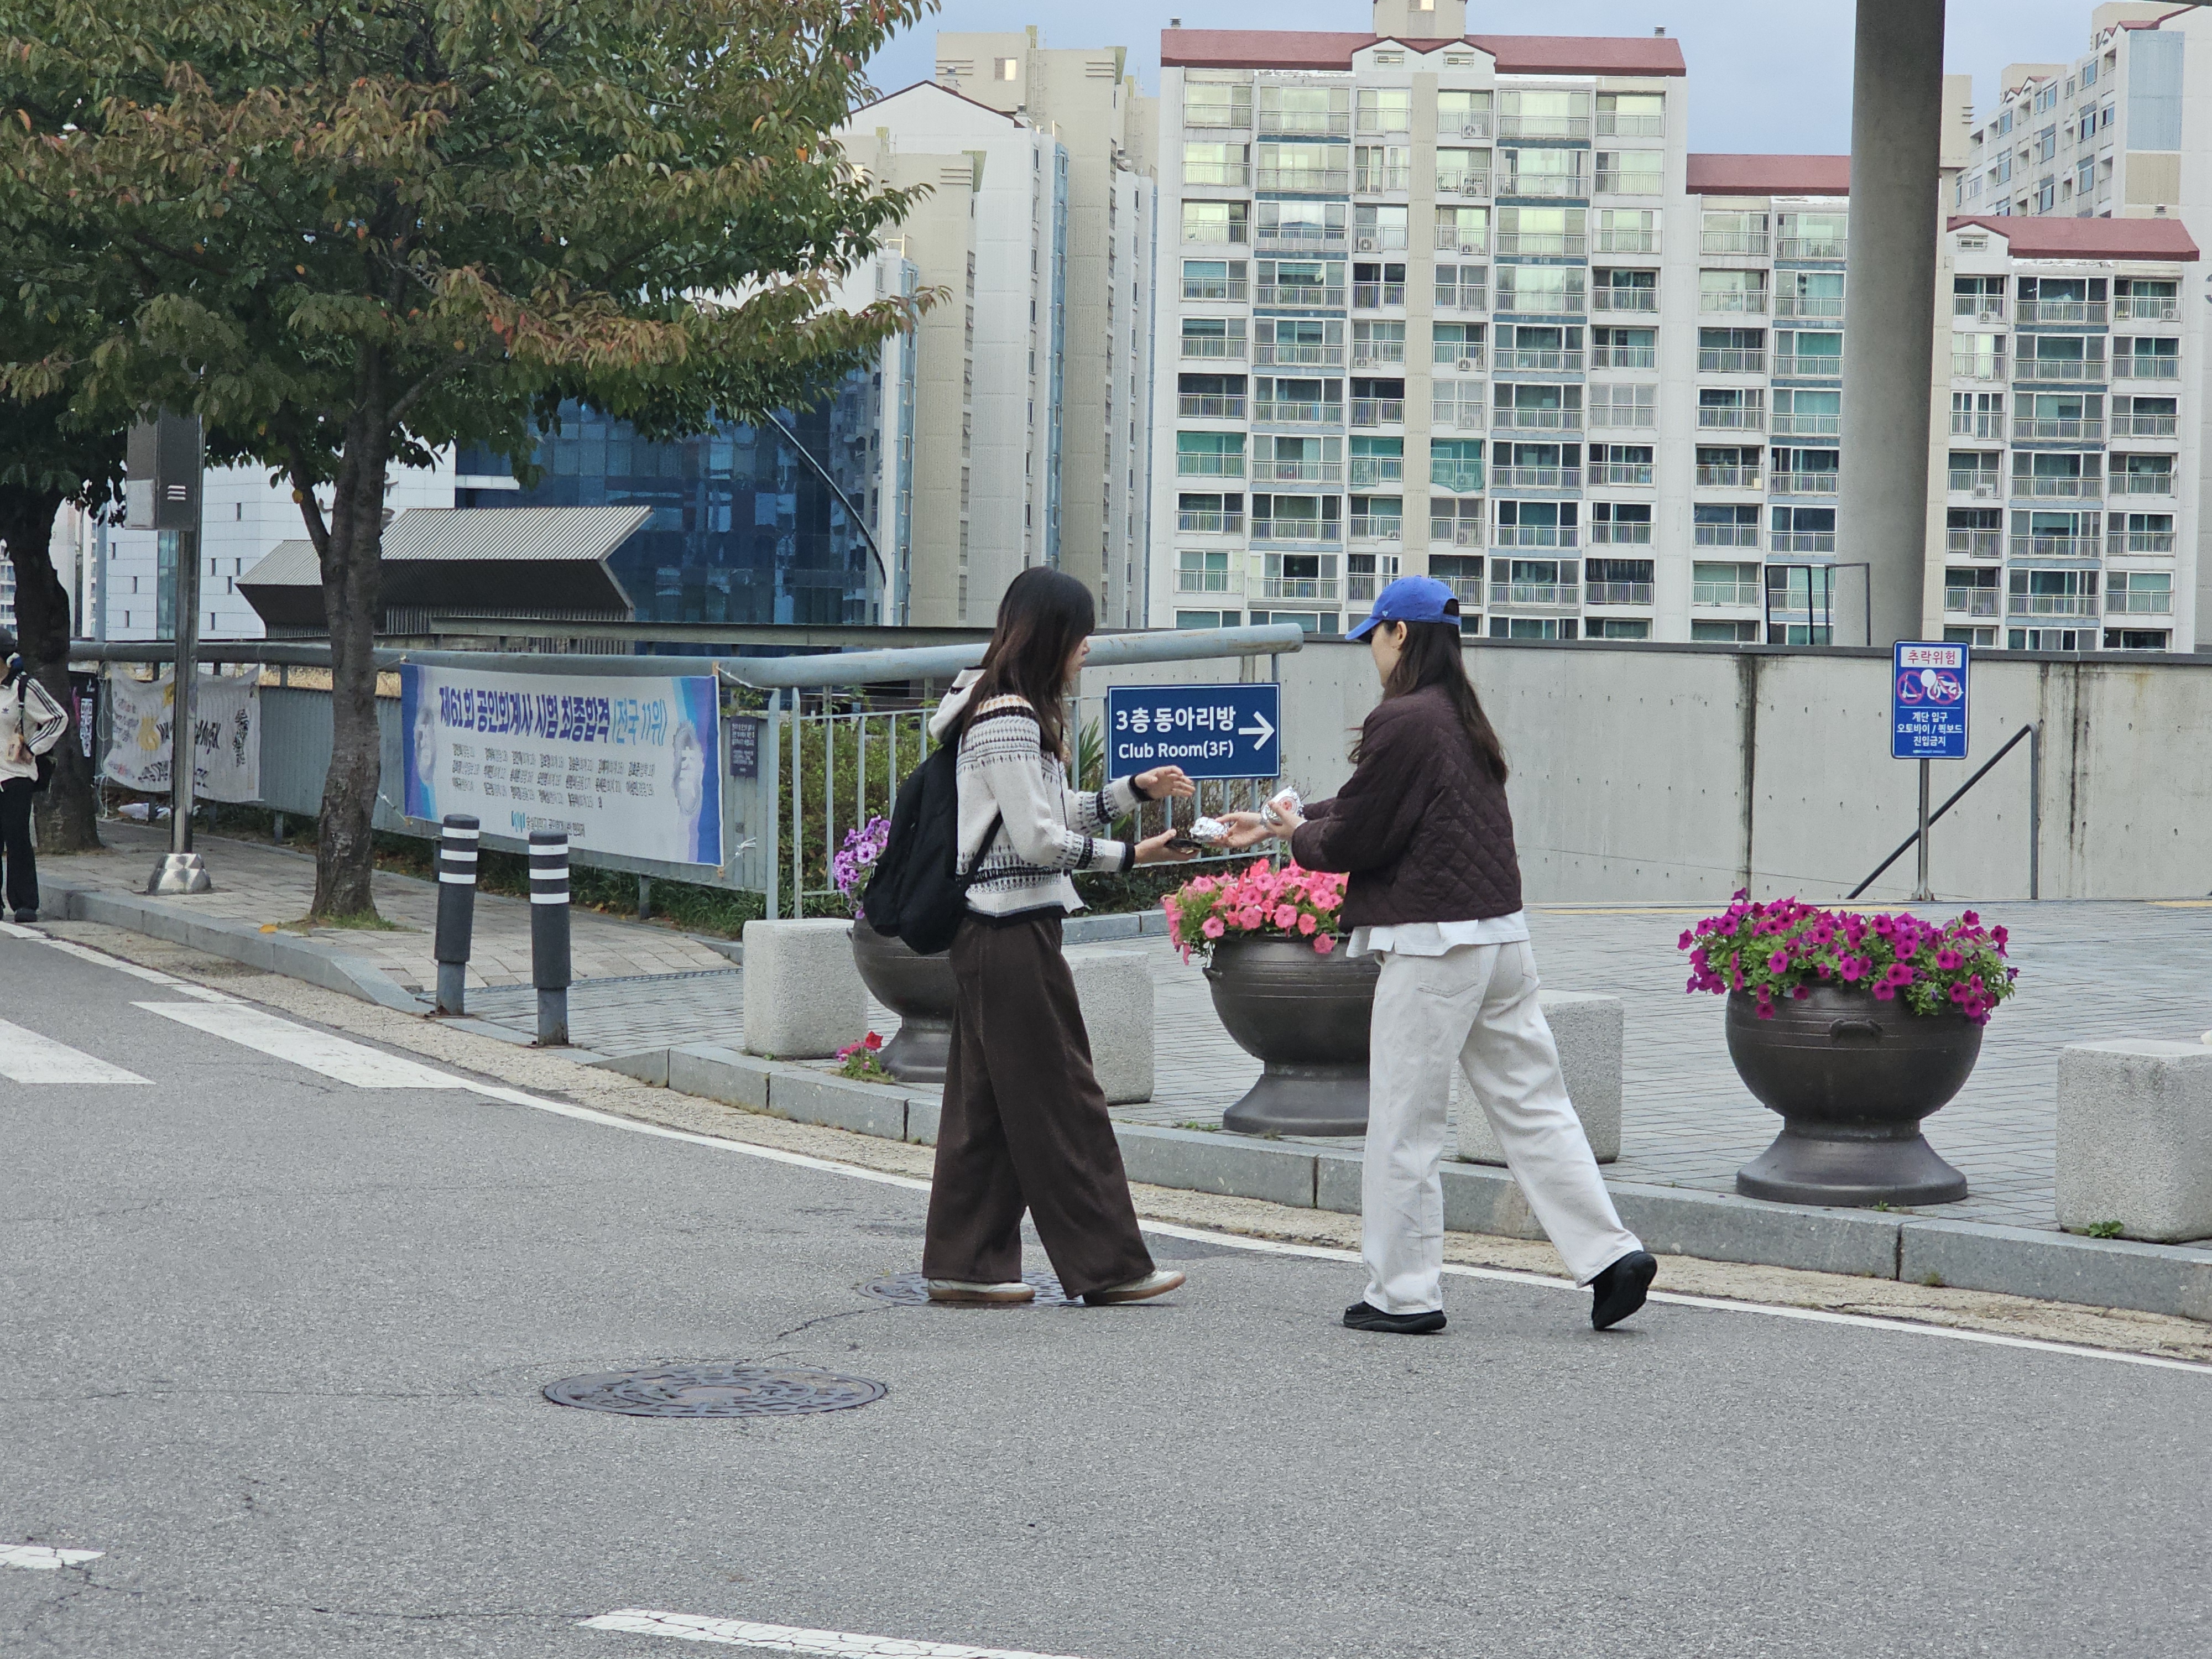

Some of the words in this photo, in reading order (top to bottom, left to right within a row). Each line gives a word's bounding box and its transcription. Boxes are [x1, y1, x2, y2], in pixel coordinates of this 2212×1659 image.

[1907, 650, 1955, 665] 추락위험
[439, 686, 474, 731] 제61회
[477, 690, 533, 737] 공인회계사
[535, 694, 559, 739] 시험
[559, 696, 610, 744] 최종합격
[612, 698, 640, 747] (전국
[641, 698, 667, 747] 11위)
[1116, 707, 1150, 733] 3층
[1154, 706, 1236, 733] 동아리방
[1912, 711, 1929, 722] 계단
[1932, 712, 1948, 722] 입구
[1897, 723, 1930, 734] 오토바이
[1932, 724, 1936, 734] /
[1938, 724, 1963, 734] 퀵보드
[1914, 735, 1945, 747] 진입금지
[1119, 743, 1154, 759] Club
[1158, 739, 1234, 759] Room(3F)
